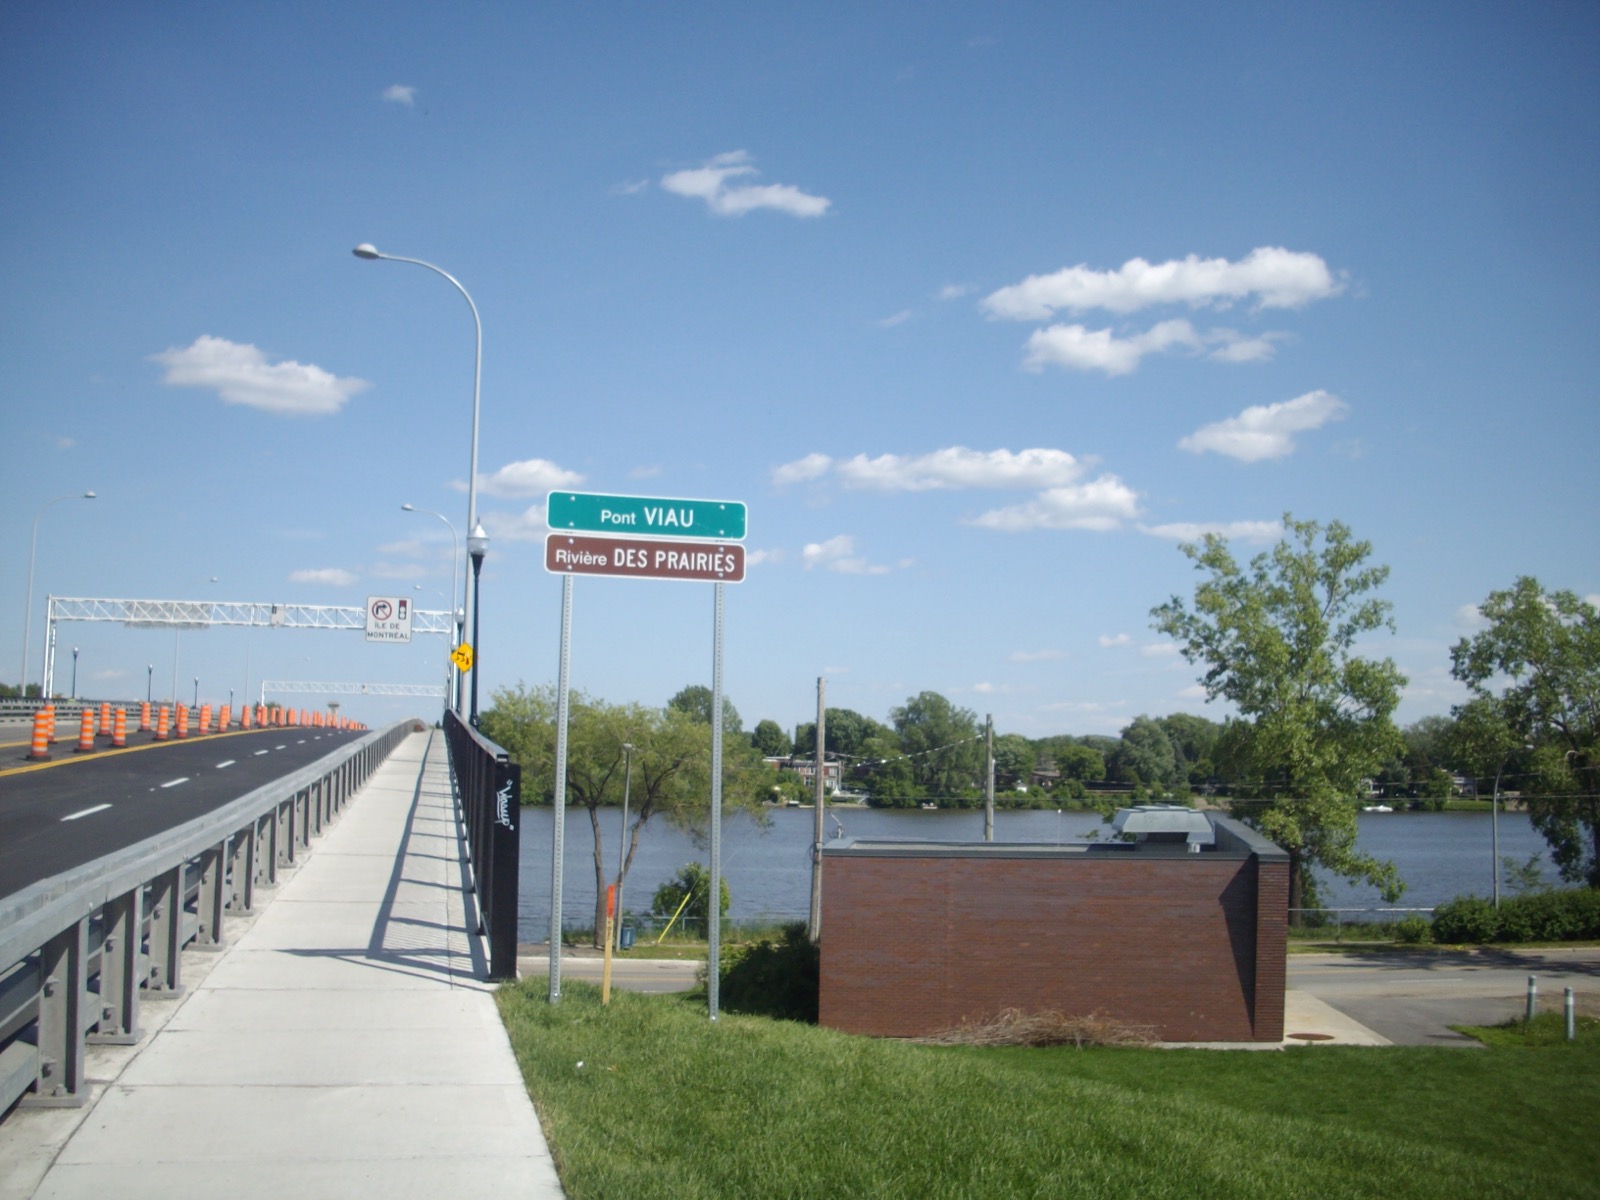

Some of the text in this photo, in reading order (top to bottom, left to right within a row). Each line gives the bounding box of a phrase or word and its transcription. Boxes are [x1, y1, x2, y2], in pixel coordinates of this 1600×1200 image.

[601, 507, 694, 527] Pont VIAU
[556, 548, 735, 573] Rivière DES PRAIRIES
